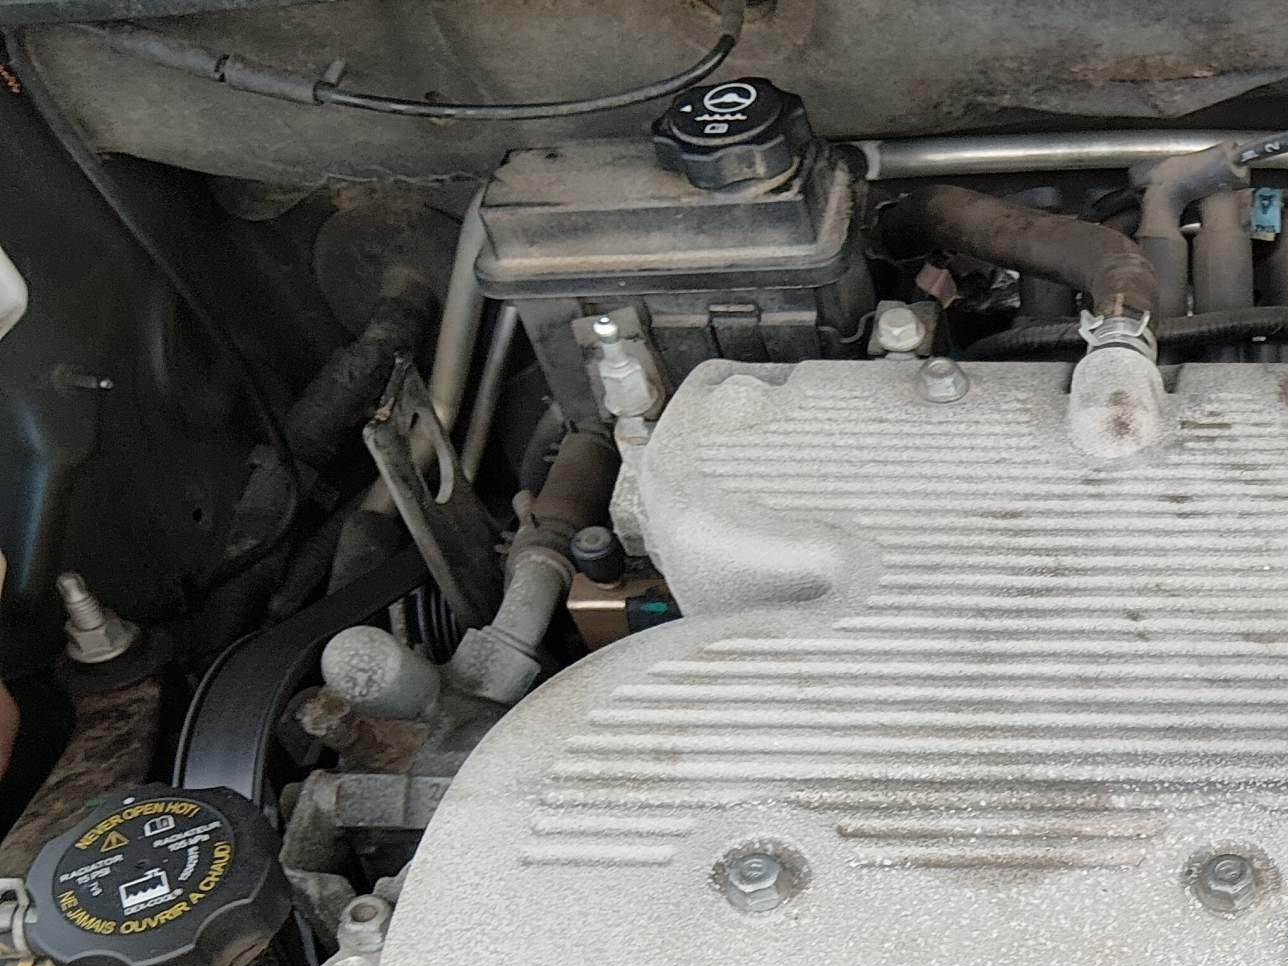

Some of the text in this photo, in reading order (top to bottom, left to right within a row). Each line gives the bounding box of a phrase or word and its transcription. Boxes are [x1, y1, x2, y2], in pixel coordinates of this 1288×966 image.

[75, 801, 201, 850] NEVER OPEN HOT!
[59, 853, 124, 883] RADIATOR
[198, 840, 233, 892] CHAUD!
[57, 890, 79, 911] NE
[66, 908, 117, 935] JAMAIS
[119, 901, 193, 935] OUVRIR
